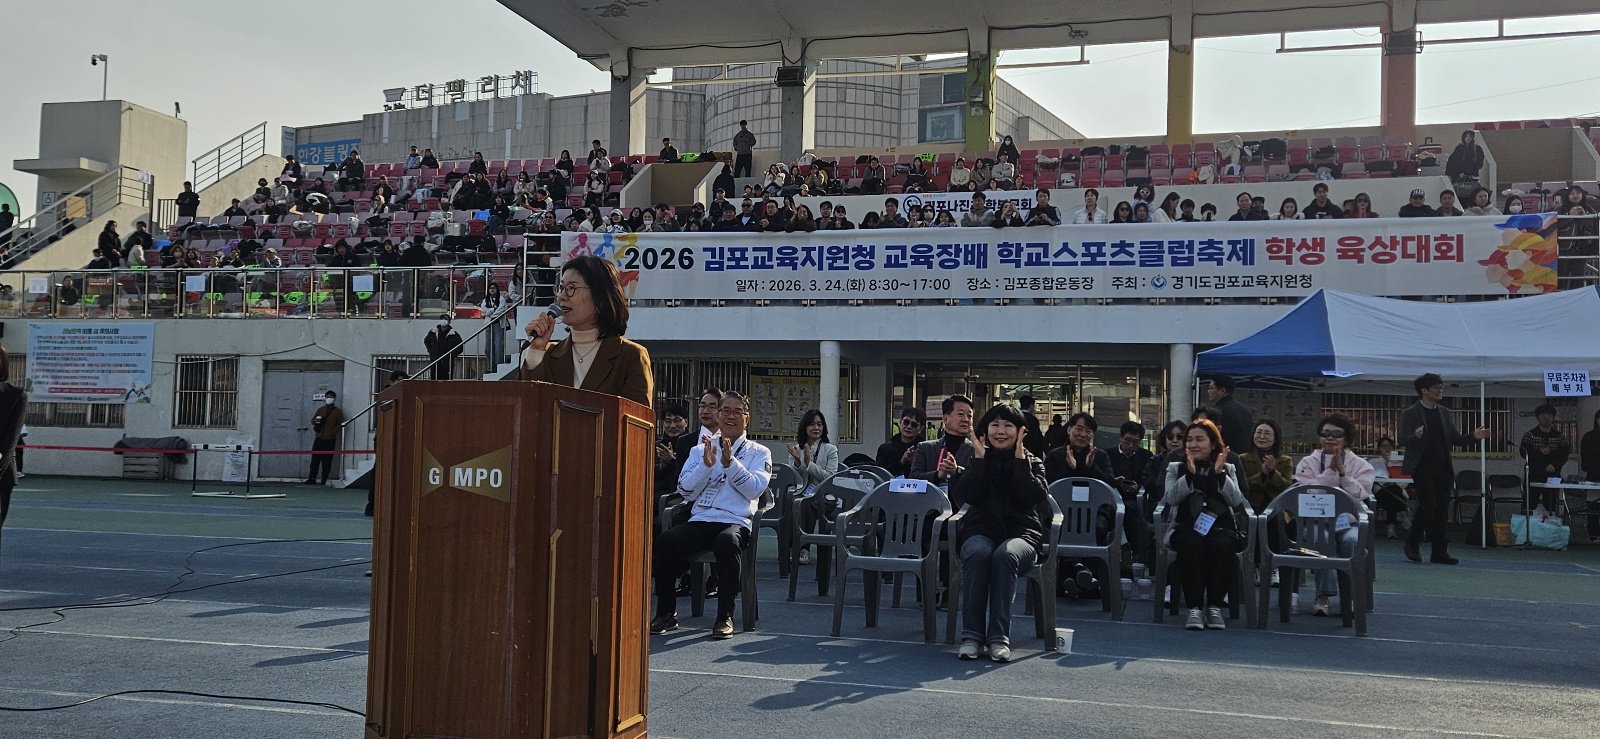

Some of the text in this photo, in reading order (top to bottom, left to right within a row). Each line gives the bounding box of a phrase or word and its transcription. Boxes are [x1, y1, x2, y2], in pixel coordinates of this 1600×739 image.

[625, 234, 1464, 272] 2026 김포교육지원청 교육장배 학교스포츠클럽축제 학생 육상대회
[735, 279, 759, 293] 일자
[768, 279, 806, 292] 2026.
[809, 279, 822, 292] 3.
[966, 277, 992, 291] 장소
[1003, 275, 1095, 291] 김포종합운동장
[1111, 275, 1138, 290] 주최
[1171, 273, 1314, 290] 경기도김포교육지원청
[767, 368, 790, 376] 응급상황
[1547, 373, 1587, 383] 무료주차권
